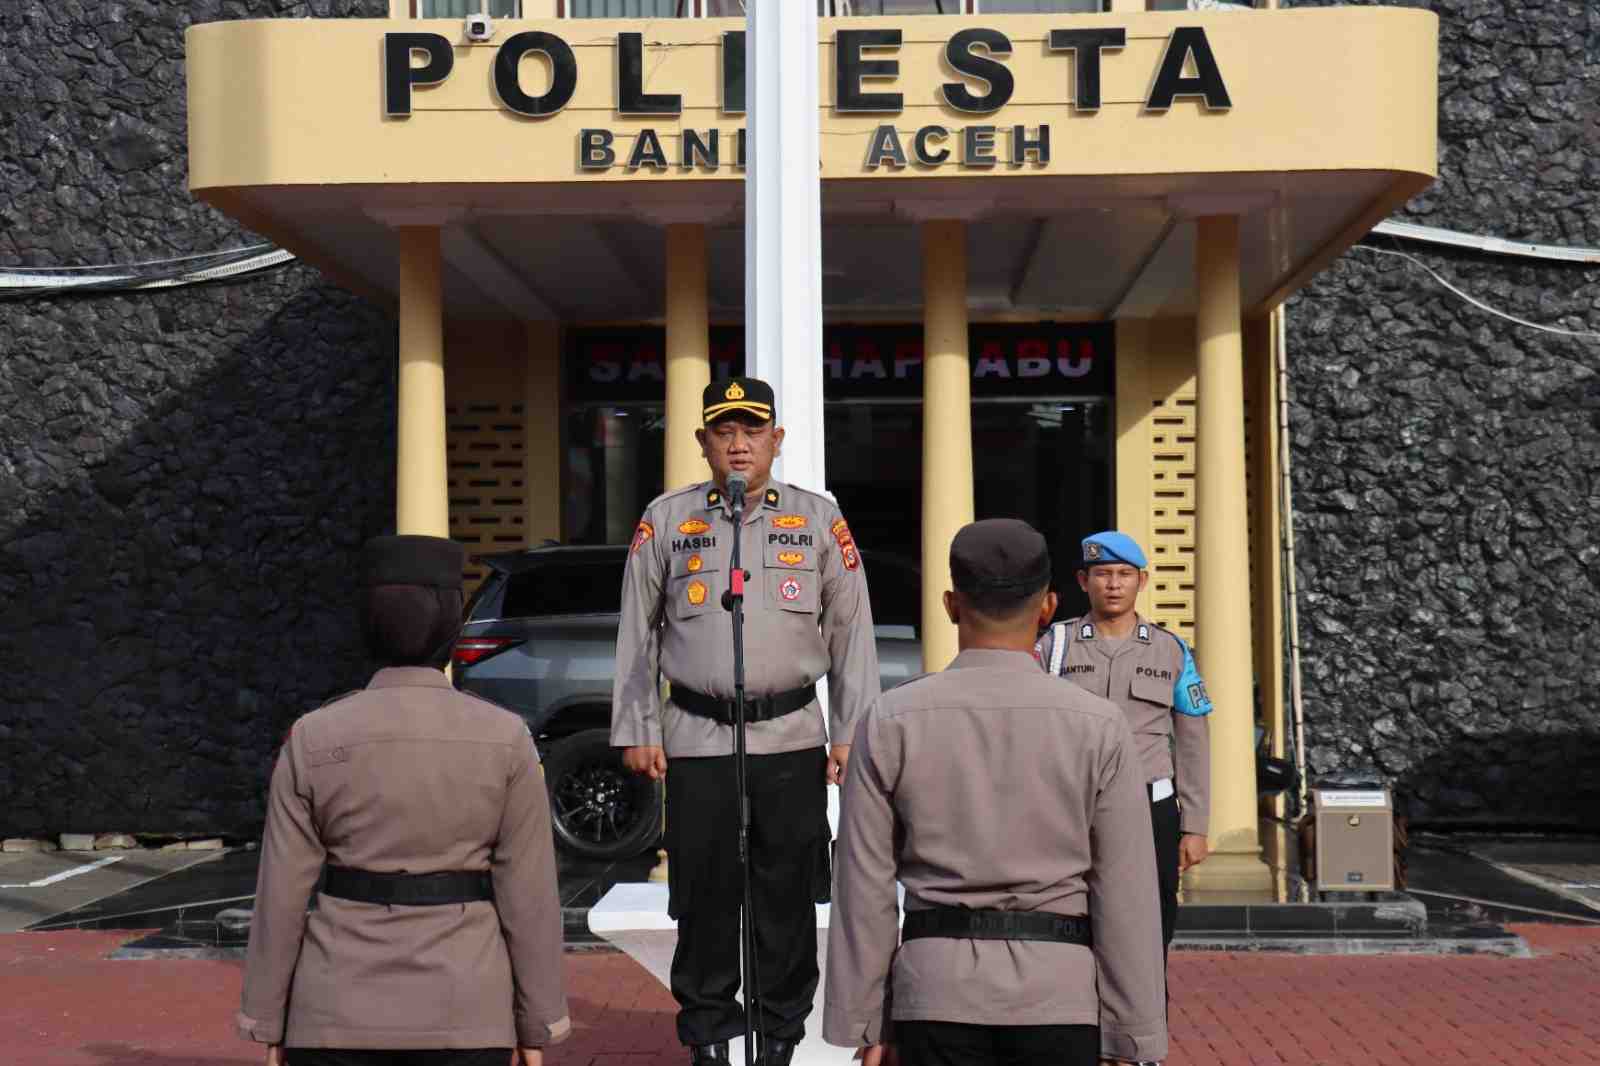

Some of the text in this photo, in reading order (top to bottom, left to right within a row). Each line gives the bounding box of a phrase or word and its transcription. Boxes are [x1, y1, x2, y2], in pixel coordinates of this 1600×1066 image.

[579, 124, 1051, 172] BAN ACEH
[672, 535, 717, 552] HASBI
[768, 533, 814, 546] POLRI
[1136, 666, 1172, 681] POLRI
